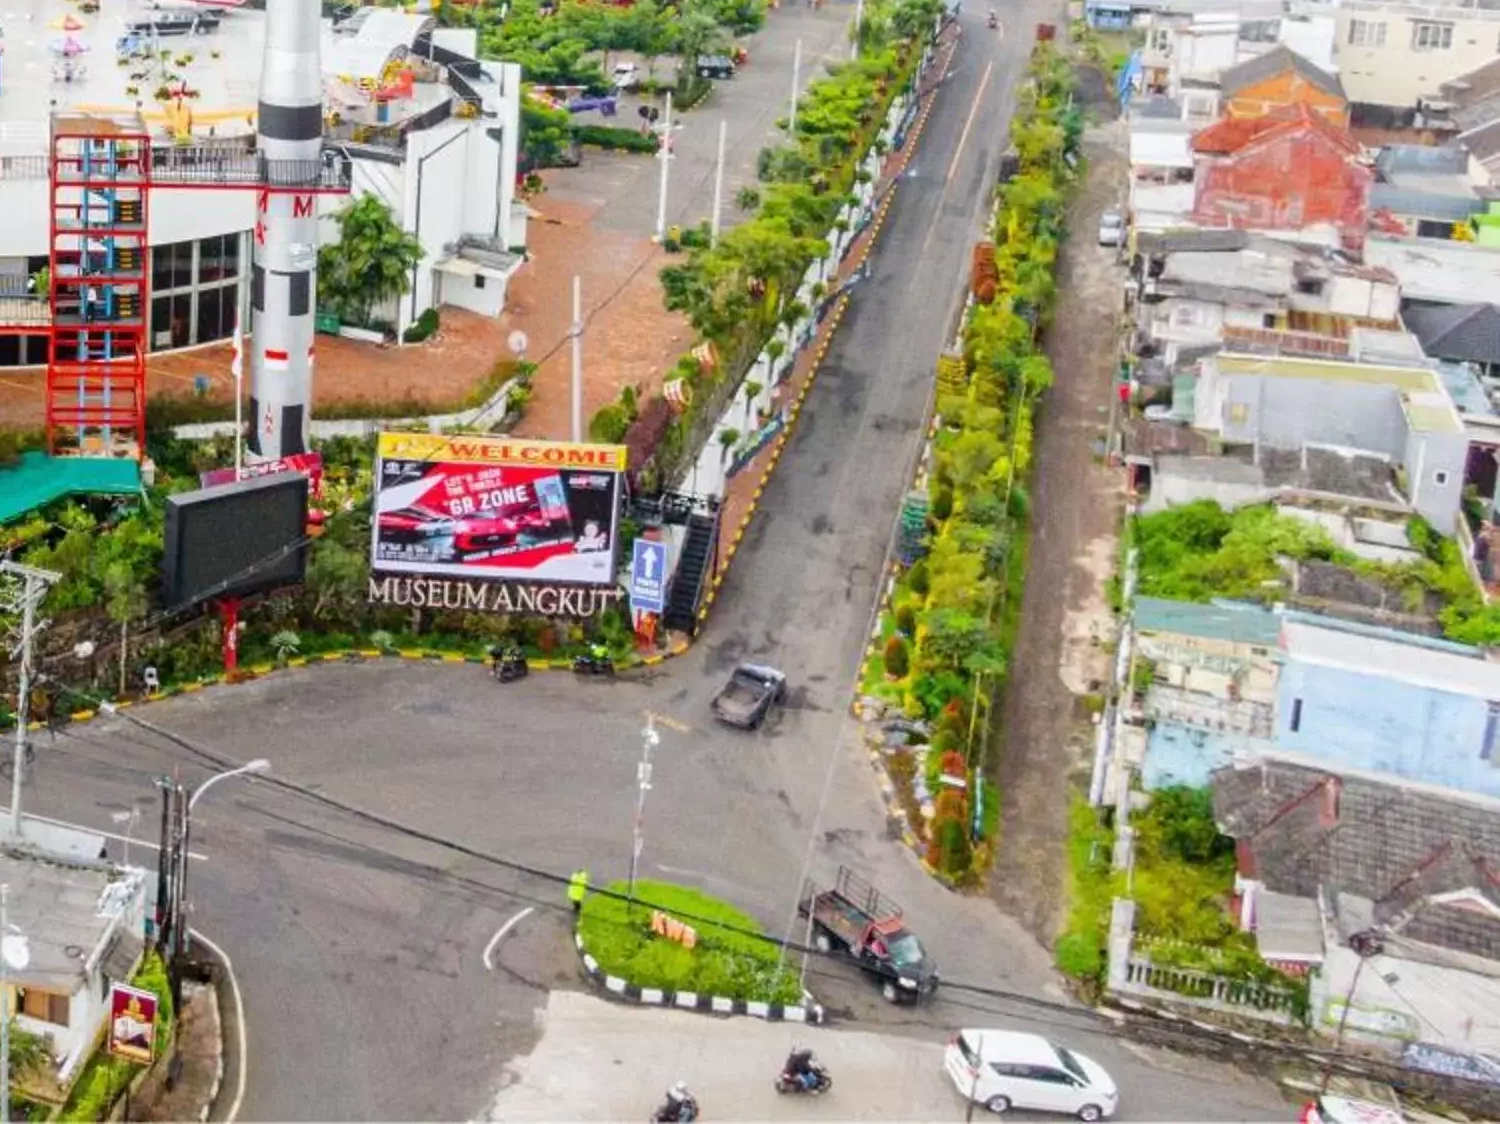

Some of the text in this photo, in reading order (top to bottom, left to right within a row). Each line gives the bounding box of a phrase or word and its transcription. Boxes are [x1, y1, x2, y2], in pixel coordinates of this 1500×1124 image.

[450, 442, 618, 466] WELCOME
[478, 485, 529, 510] ZONE
[367, 578, 490, 610] MUSEUM
